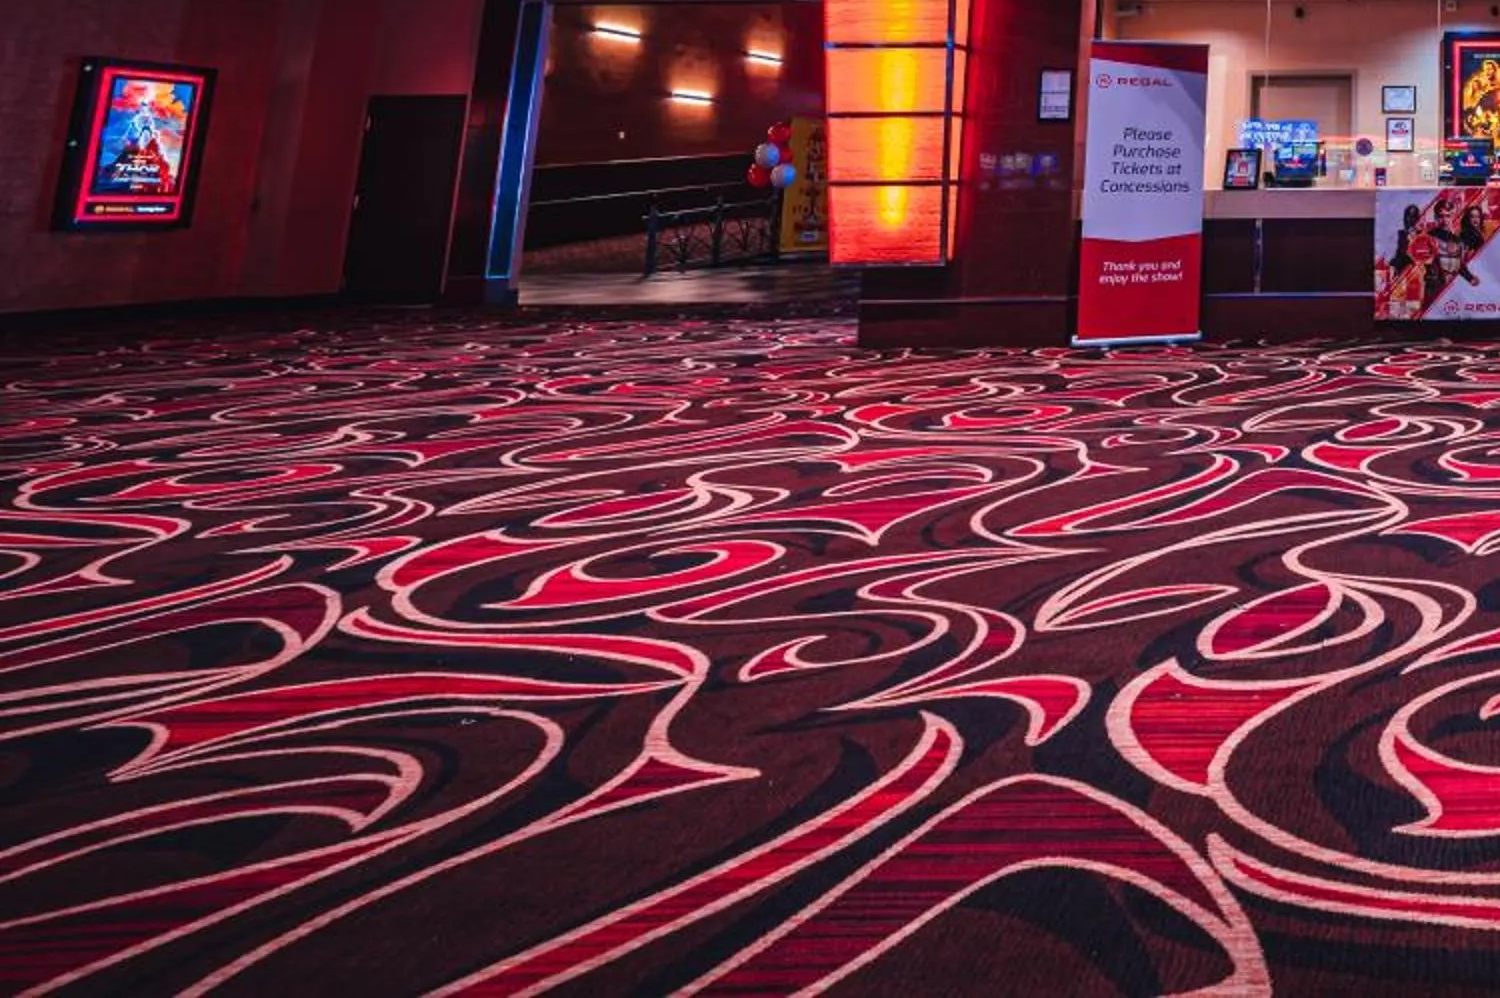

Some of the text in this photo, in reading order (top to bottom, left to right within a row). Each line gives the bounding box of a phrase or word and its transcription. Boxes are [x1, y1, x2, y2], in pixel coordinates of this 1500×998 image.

[1117, 77, 1173, 87] REGAL
[1122, 127, 1172, 141] Please
[1112, 144, 1181, 159] Purchase
[1112, 162, 1181, 175] Tickets at
[1100, 179, 1190, 193] Concessions
[1103, 260, 1181, 274] Thank you and
[1099, 273, 1129, 285] enjoy
[1131, 273, 1149, 283] the
